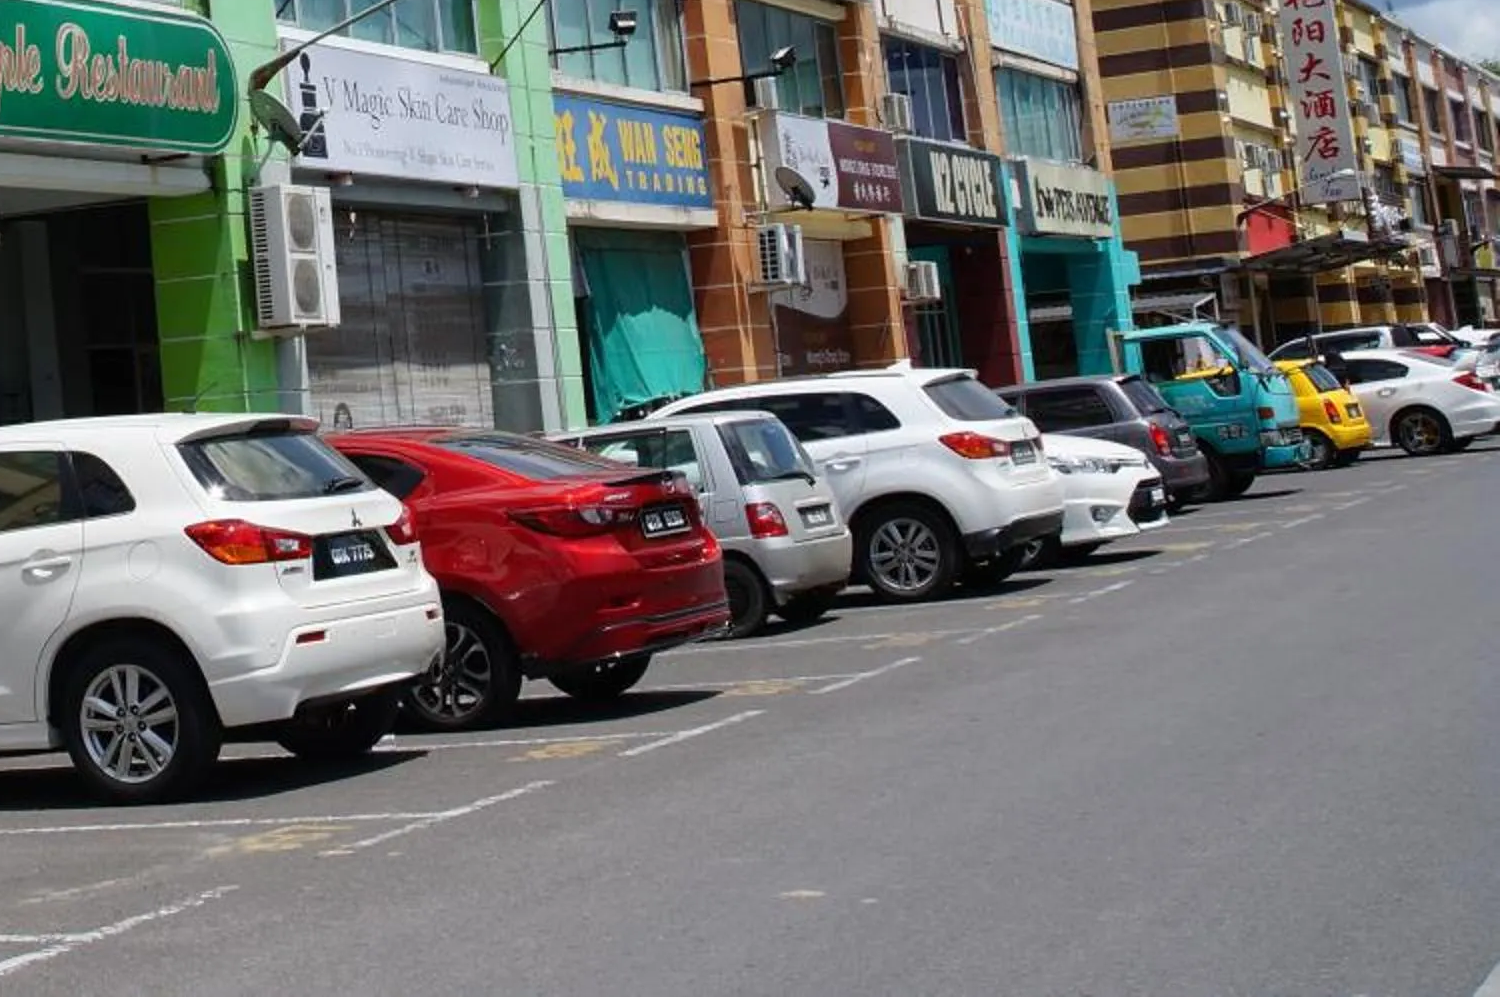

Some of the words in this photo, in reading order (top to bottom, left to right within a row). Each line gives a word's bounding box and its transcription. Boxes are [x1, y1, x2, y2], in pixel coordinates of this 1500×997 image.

[55, 22, 220, 115] Restaurant
[342, 79, 393, 130] Magic
[397, 86, 432, 124] Skin
[433, 92, 470, 126] Care
[472, 98, 510, 145] Shop
[616, 118, 657, 165] WAN
[662, 124, 704, 171] SENG
[625, 171, 708, 195] TRADING
